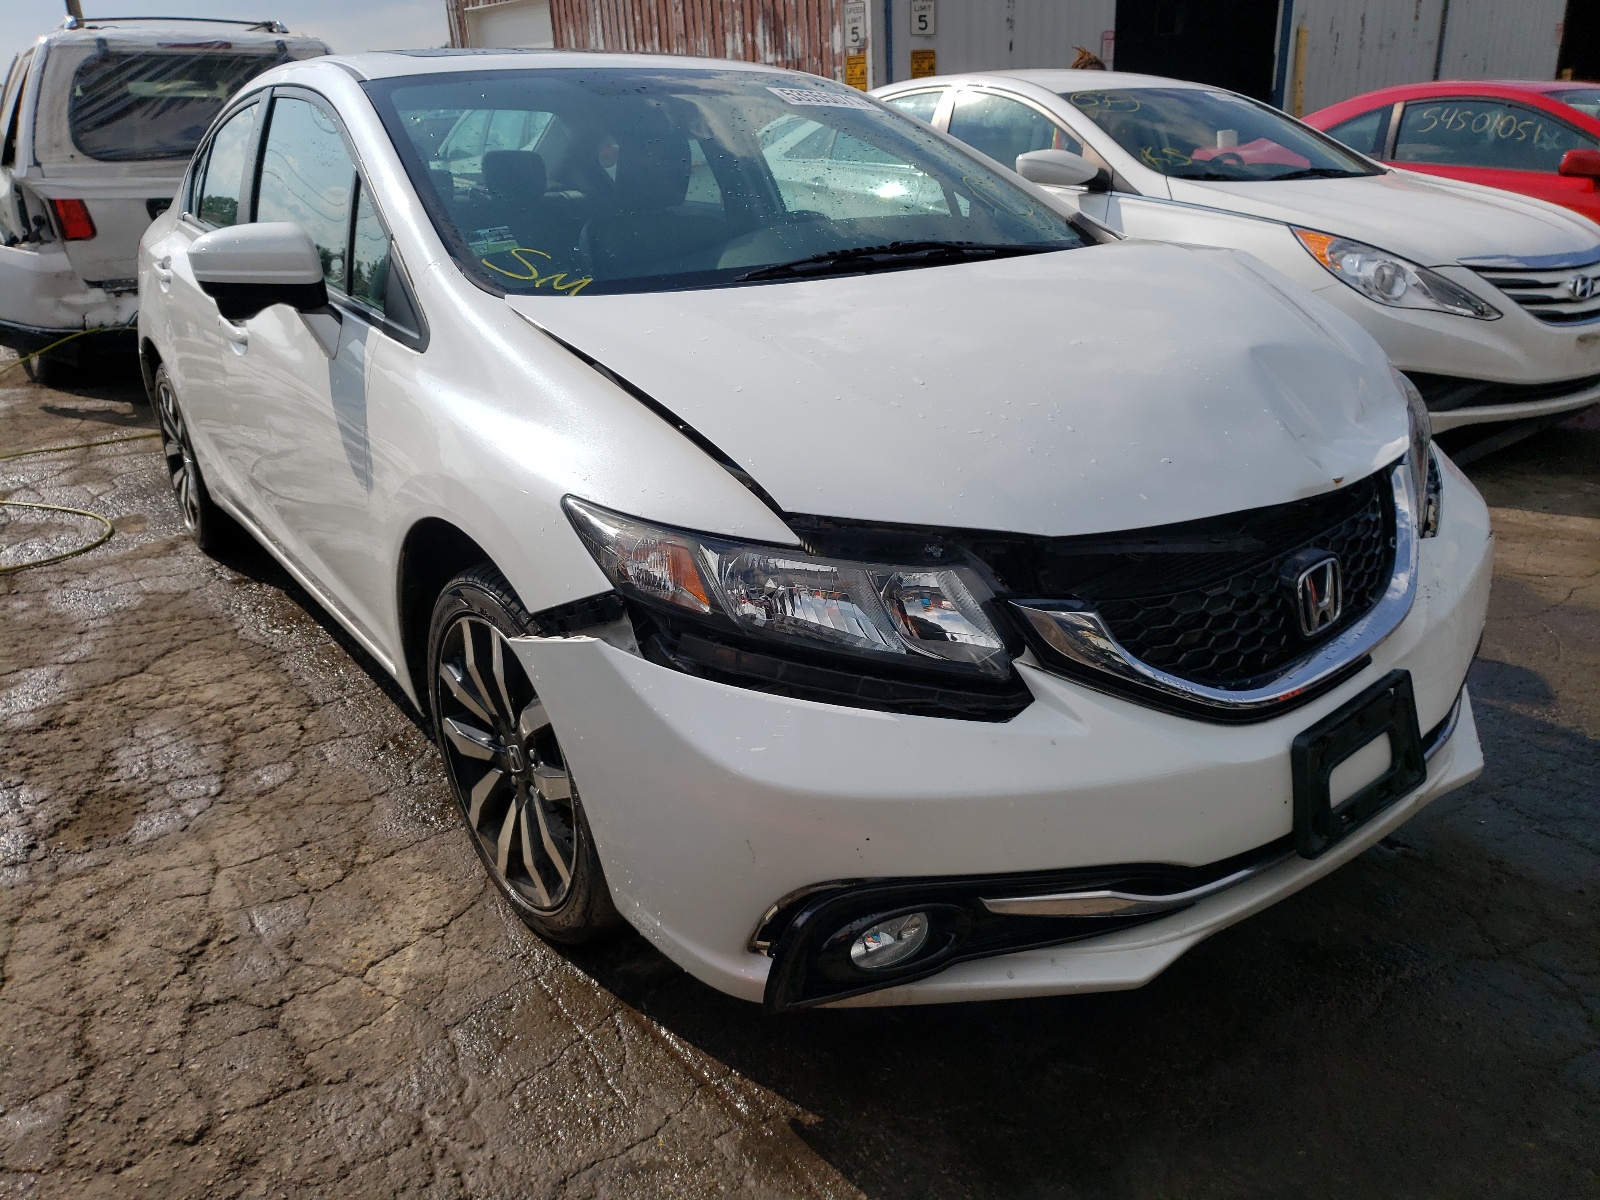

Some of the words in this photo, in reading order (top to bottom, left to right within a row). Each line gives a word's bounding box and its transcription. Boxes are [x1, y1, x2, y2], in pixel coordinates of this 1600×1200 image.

[846, 6, 863, 14] SPEED
[848, 16, 862, 24] LIMIT
[918, 15, 928, 31] 5
[851, 26, 860, 43] 5
